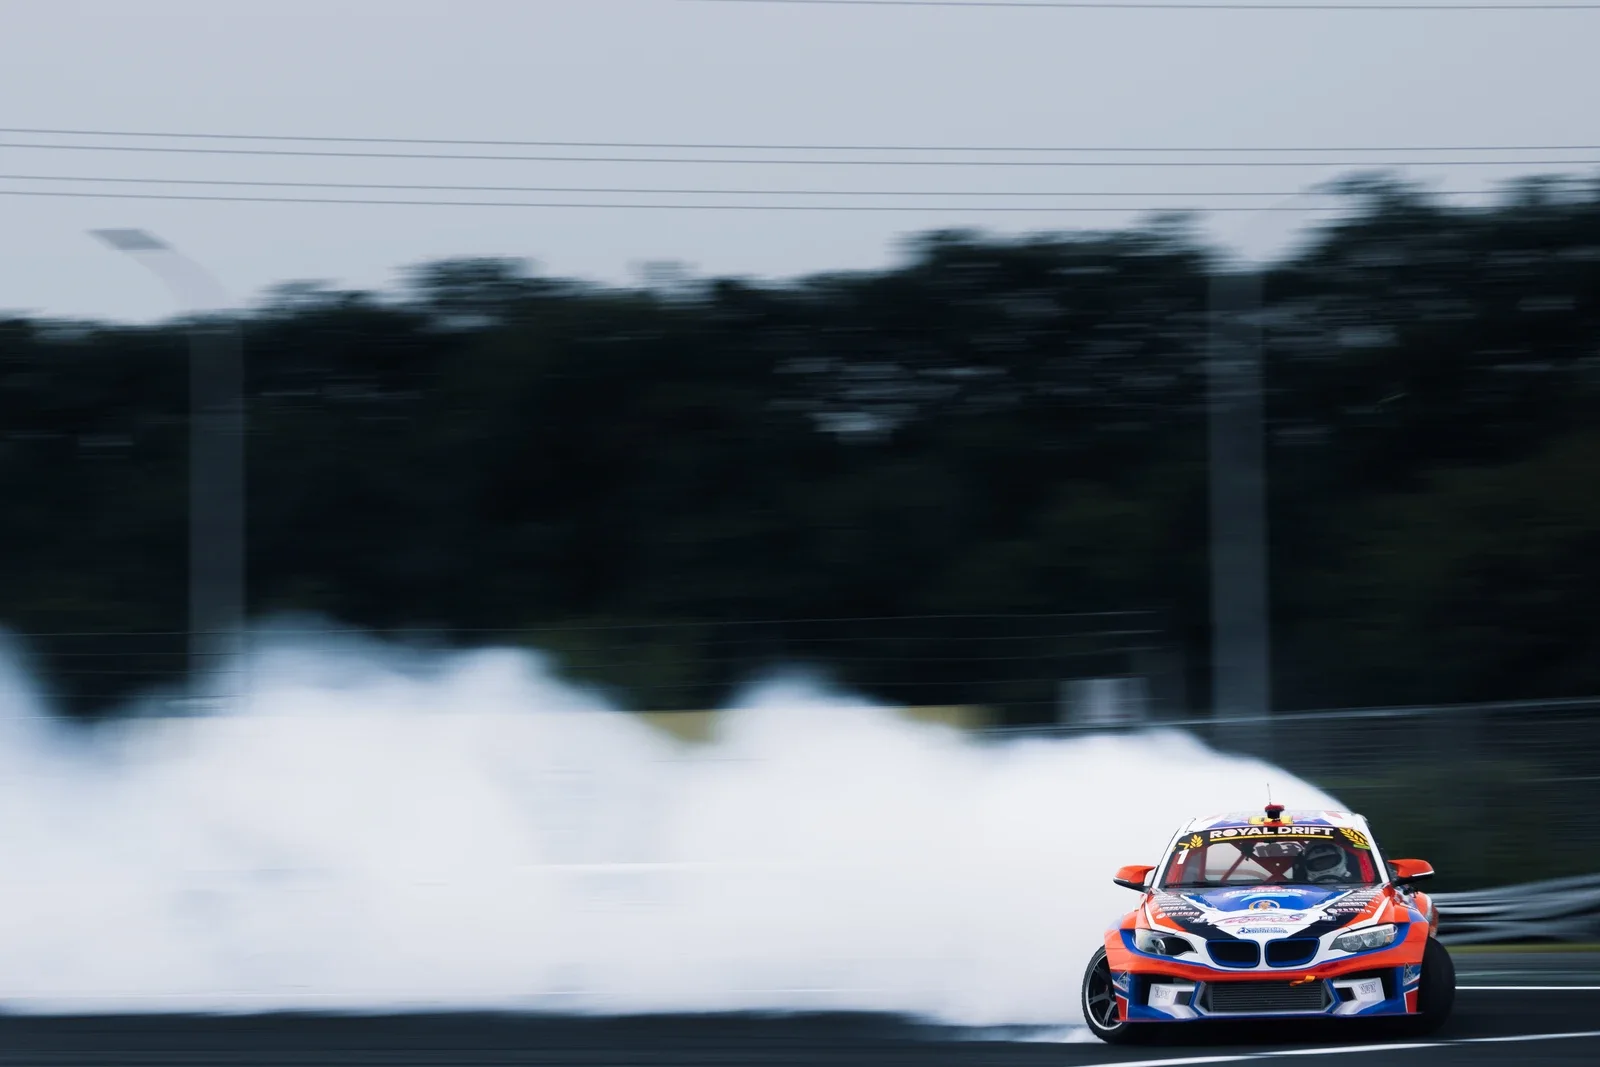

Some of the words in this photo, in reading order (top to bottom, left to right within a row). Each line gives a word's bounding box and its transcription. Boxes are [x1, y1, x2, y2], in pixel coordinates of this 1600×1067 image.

[1210, 827, 1275, 839] ROYAL
[1278, 826, 1333, 836] DRIFT
[1177, 849, 1189, 864] 1
